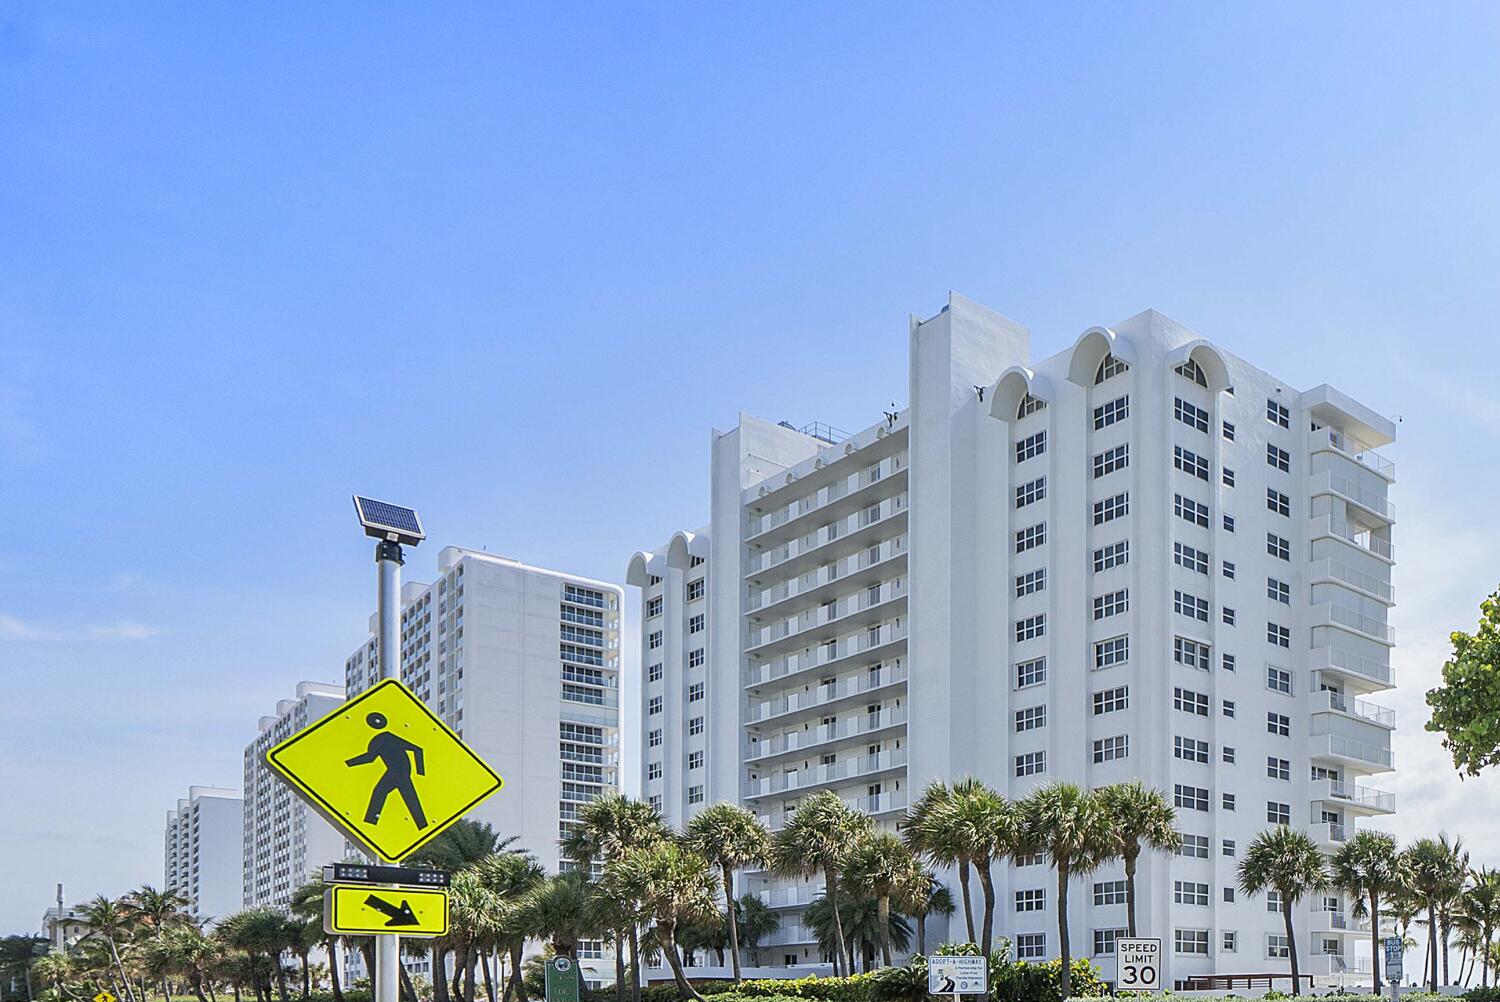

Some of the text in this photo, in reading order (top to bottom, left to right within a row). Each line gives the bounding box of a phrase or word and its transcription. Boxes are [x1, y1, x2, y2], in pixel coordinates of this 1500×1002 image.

[1121, 944, 1157, 952] SPEED
[1125, 955, 1154, 963] LIMIT
[1122, 966, 1156, 985] 30
